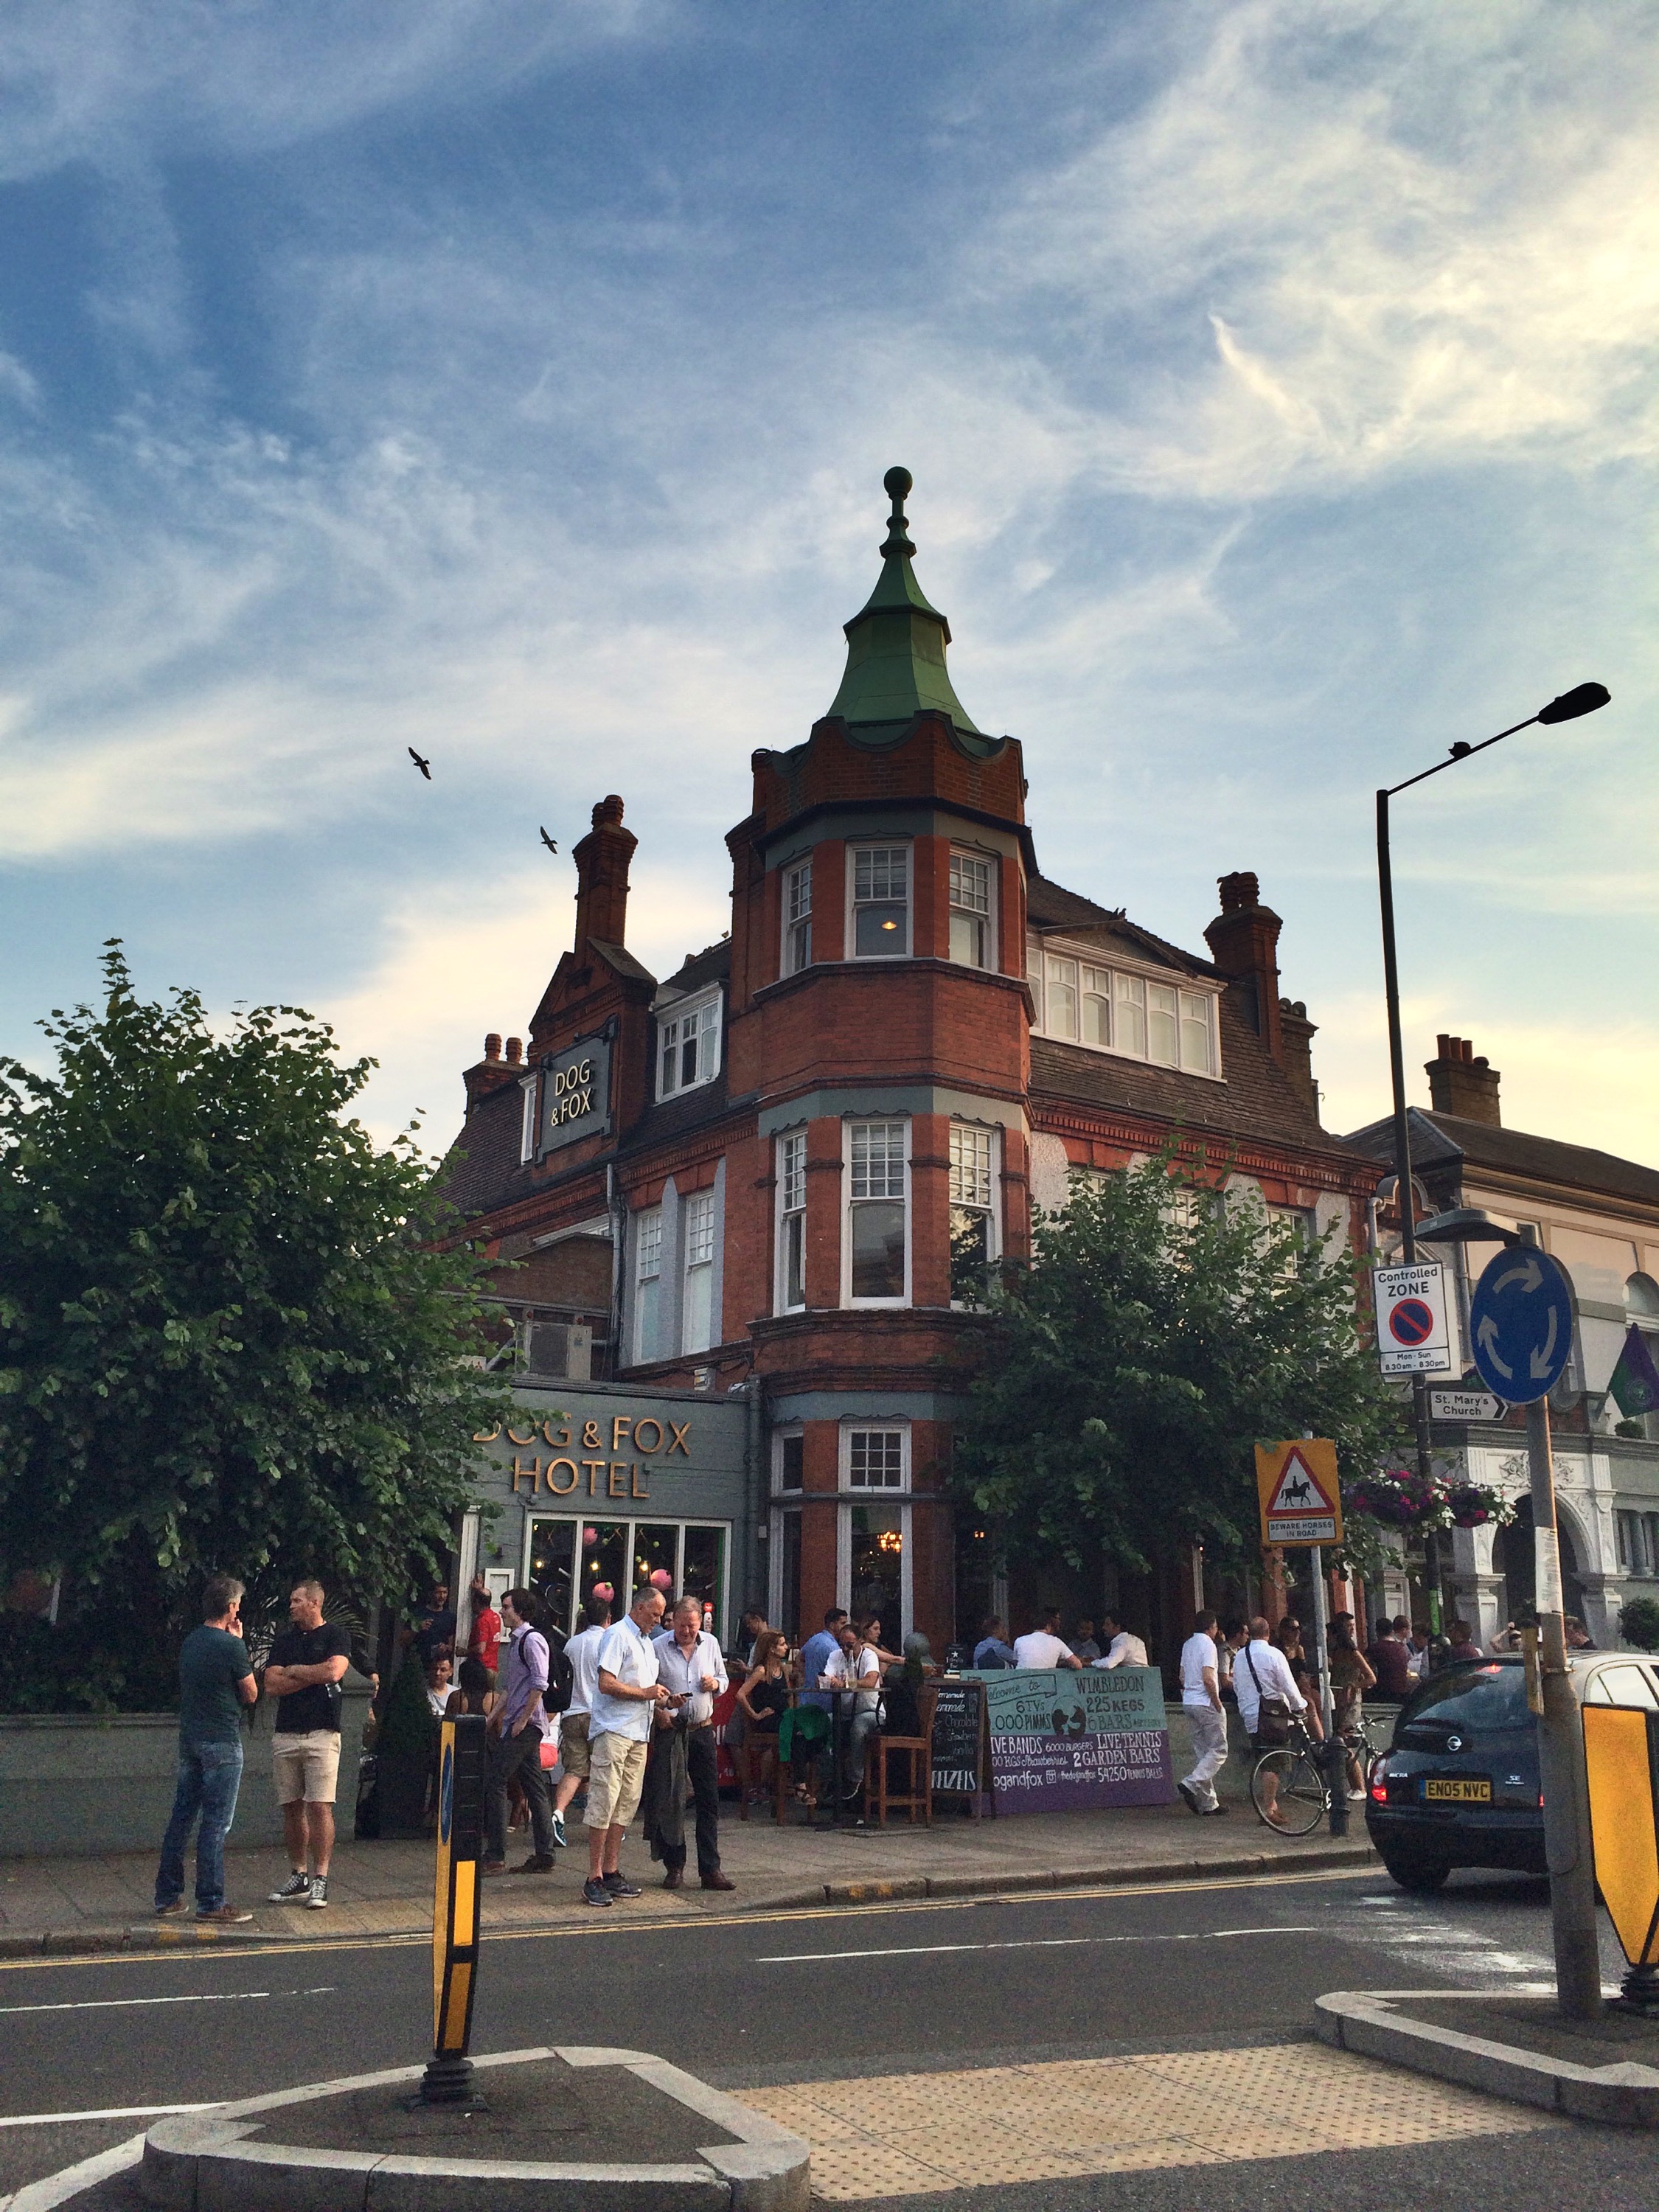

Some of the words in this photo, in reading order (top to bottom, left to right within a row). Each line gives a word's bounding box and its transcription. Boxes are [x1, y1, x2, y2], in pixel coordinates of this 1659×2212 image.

[555, 1059, 590, 1096] DOG
[1378, 1267, 1438, 1283] Controlled
[1388, 1281, 1429, 1297] ZONE
[1435, 1395, 1450, 1405] St.
[1454, 1395, 1489, 1407] Mary's
[1443, 1406, 1482, 1416] Church
[582, 1420, 602, 1448] &
[613, 1416, 692, 1455] FOX
[513, 1456, 650, 1498] HOTEL
[988, 1686, 1021, 1700] elcome
[1029, 1680, 1041, 1691] to
[1075, 1675, 1144, 1694] WIMBLEDON
[936, 1700, 965, 1712] emonade
[1086, 1696, 1110, 1713] 225
[1112, 1699, 1145, 1712] KEGS
[1024, 1714, 1051, 1731] PIMMS
[1088, 1715, 1097, 1731] 6
[1097, 1714, 1133, 1731] BARS
[990, 1736, 1007, 1754] IVE
[1008, 1736, 1043, 1754] BANDS
[1045, 1742, 1065, 1752] 6000
[1065, 1742, 1093, 1751] BURGERS
[1096, 1733, 1121, 1750] LIVE
[1121, 1731, 1162, 1748] TENNIS
[1004, 1756, 1020, 1767] KGS
[1073, 1752, 1082, 1767] 2
[1082, 1750, 1127, 1766] GARDEN
[1128, 1748, 1161, 1764] BARS
[931, 1770, 976, 1792] RETZELS
[993, 1770, 1043, 1791] ogandfox
[1097, 1767, 1127, 1783] 54250
[1428, 1781, 1460, 1797] EN05
[1464, 1783, 1488, 1798] NVC
